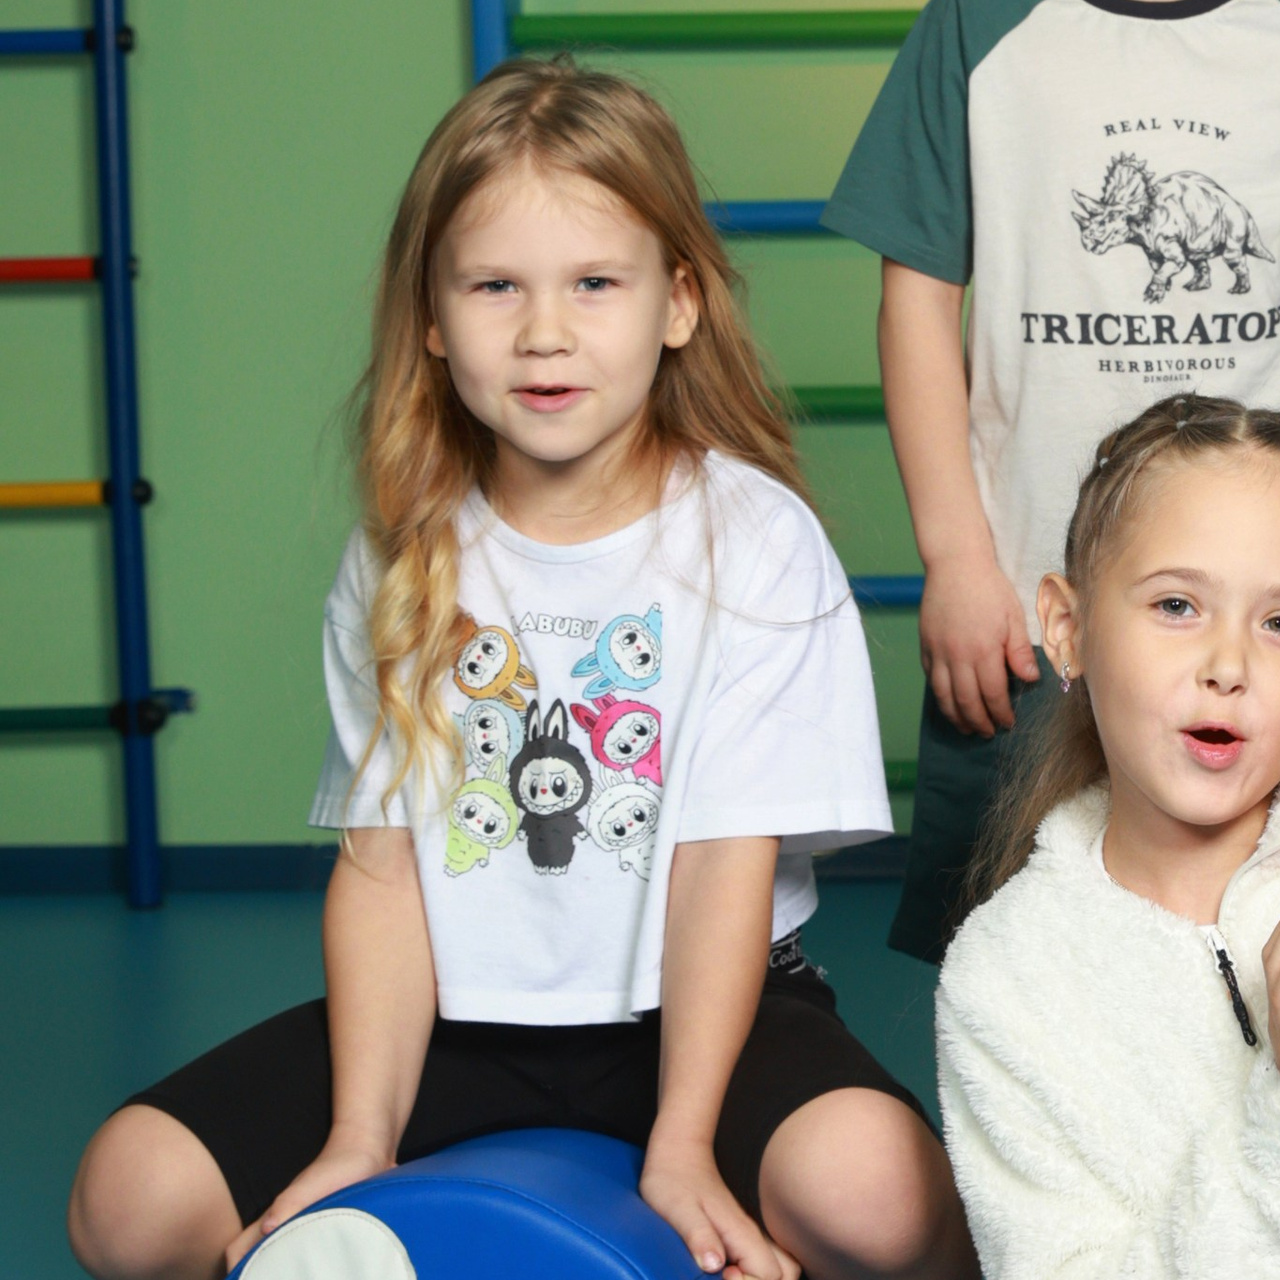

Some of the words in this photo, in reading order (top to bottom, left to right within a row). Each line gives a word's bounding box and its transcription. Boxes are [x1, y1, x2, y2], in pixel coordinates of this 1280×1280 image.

[1103, 118, 1161, 136] REAL
[1173, 119, 1231, 141] VIEW
[1098, 357, 1236, 372] HERBIVOROUS
